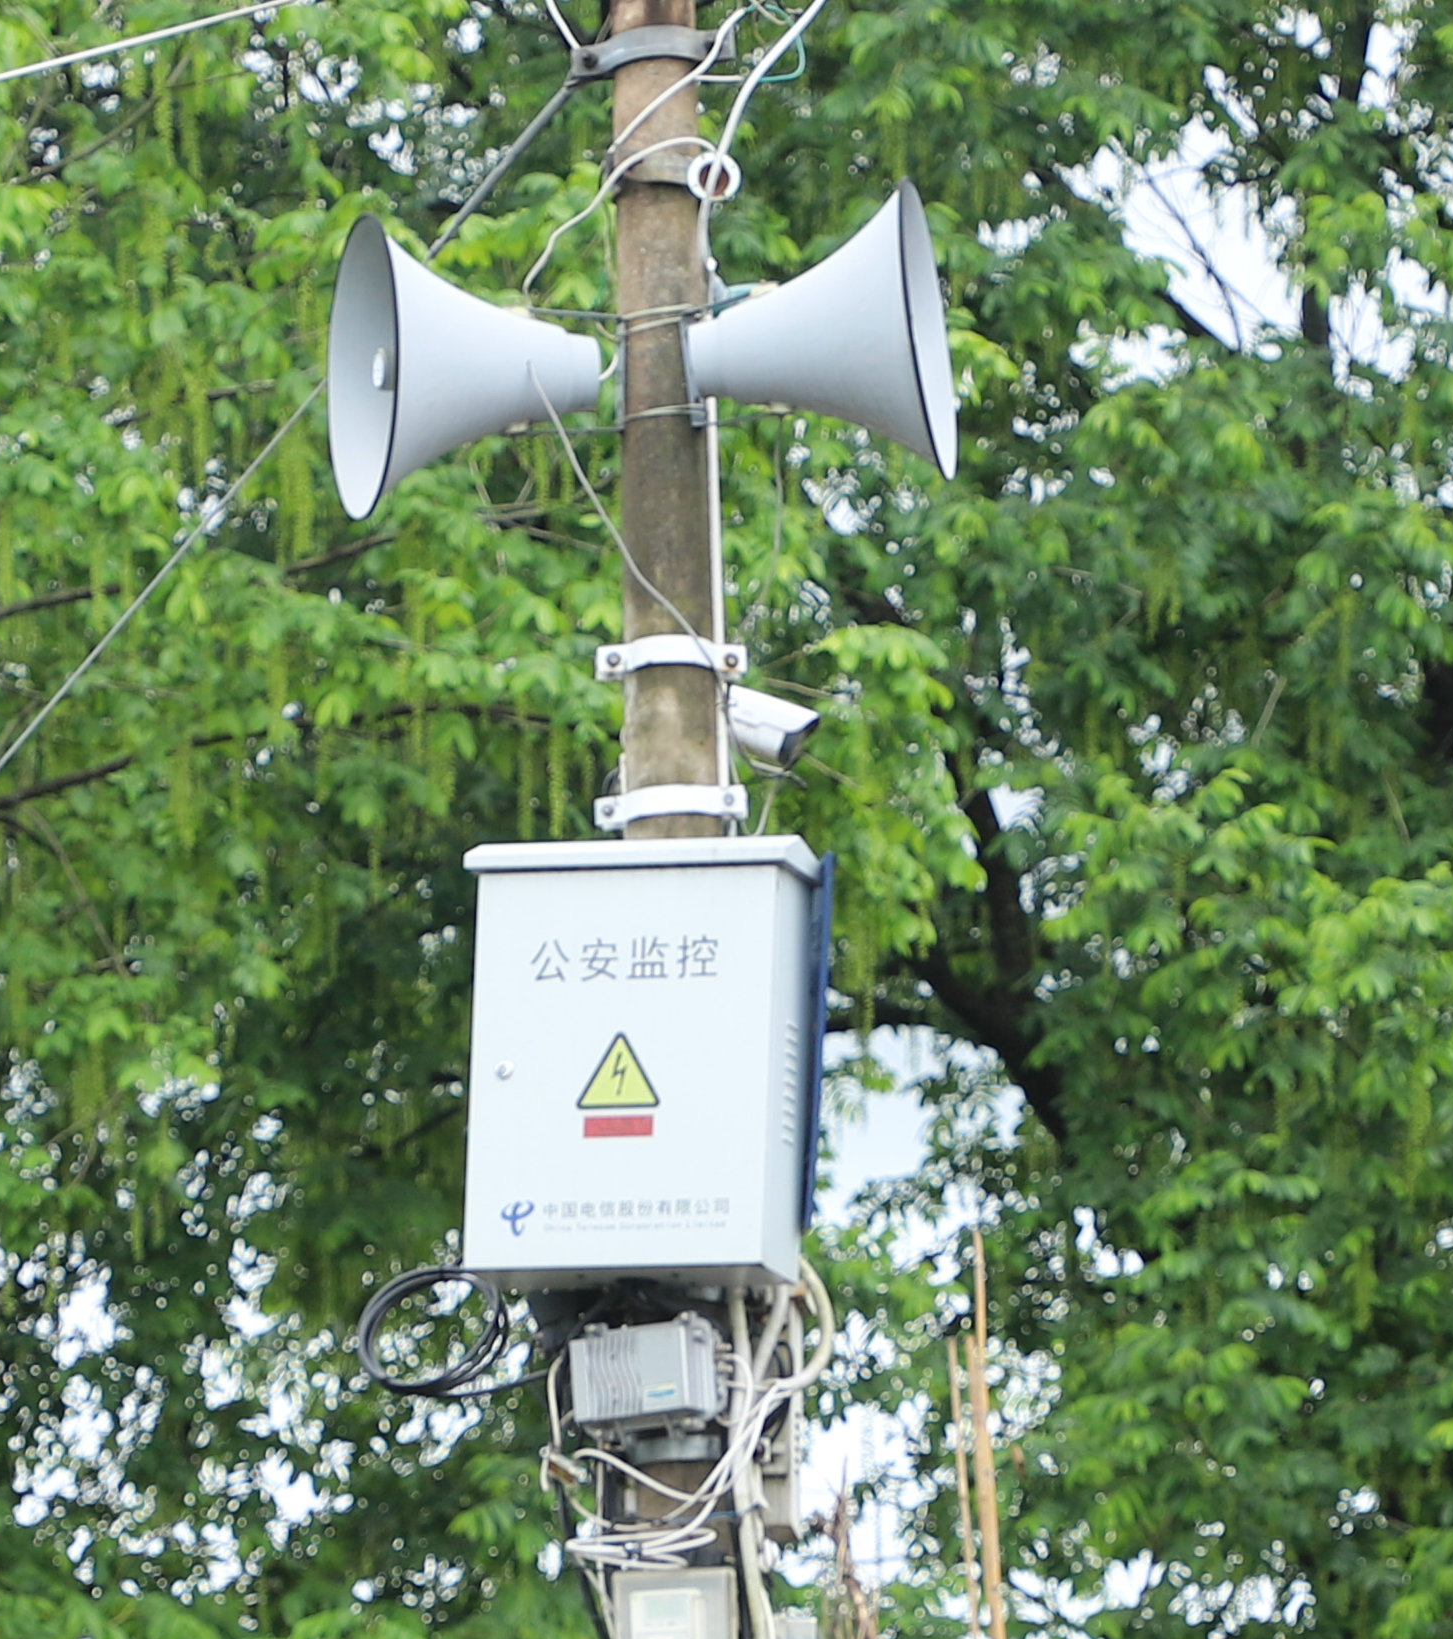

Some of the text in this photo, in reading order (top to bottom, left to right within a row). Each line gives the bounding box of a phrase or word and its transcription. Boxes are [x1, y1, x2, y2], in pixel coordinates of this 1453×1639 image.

[530, 934, 719, 982] 公安监控
[543, 1197, 730, 1218] 中国电信股份有限公司
